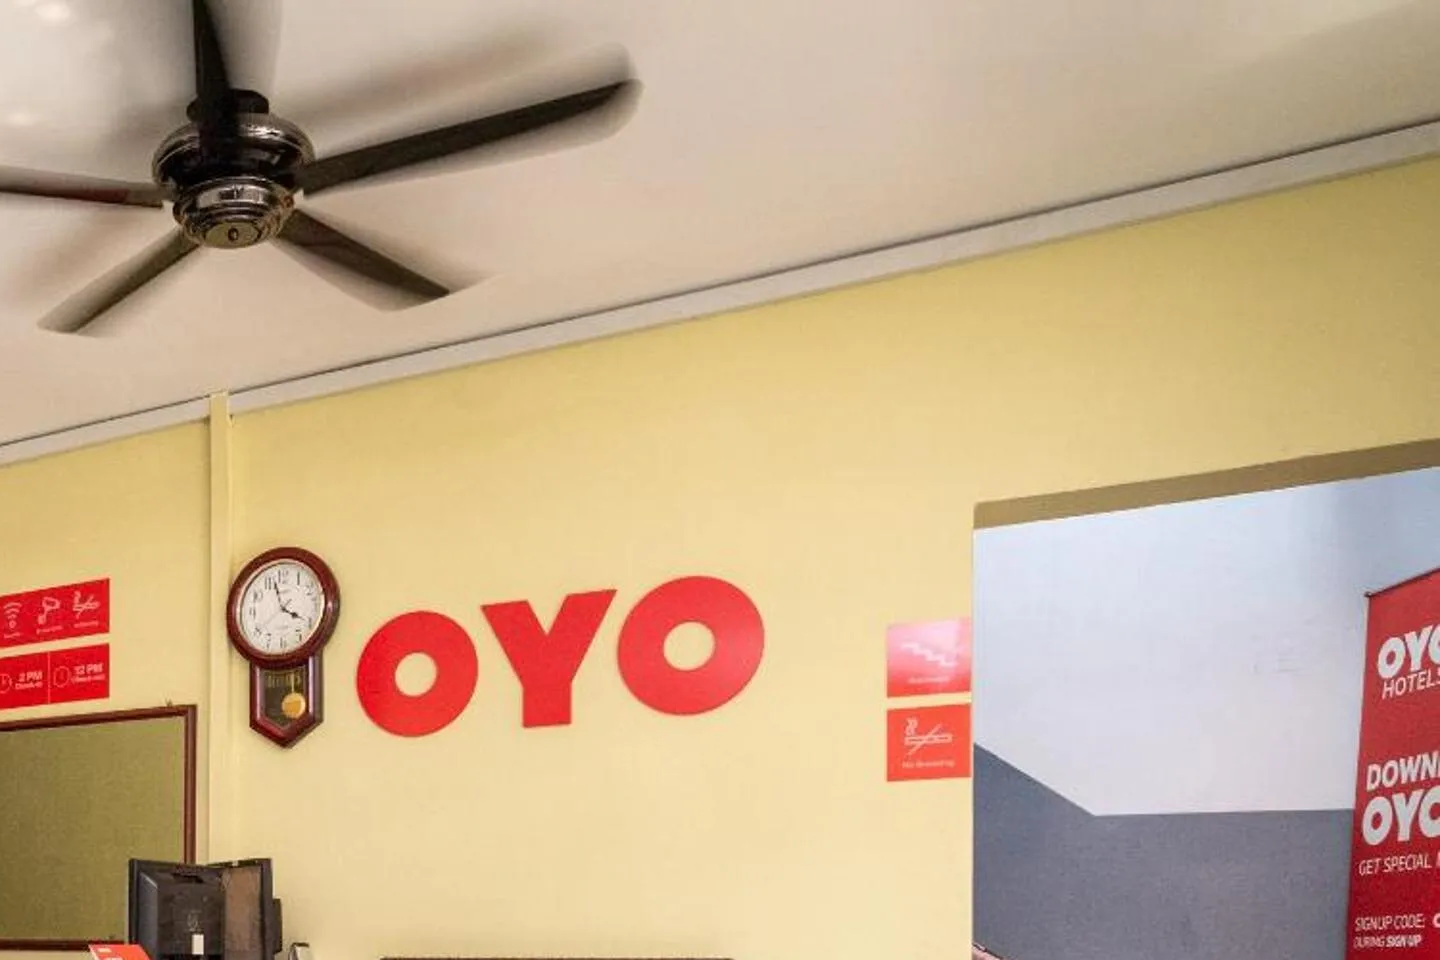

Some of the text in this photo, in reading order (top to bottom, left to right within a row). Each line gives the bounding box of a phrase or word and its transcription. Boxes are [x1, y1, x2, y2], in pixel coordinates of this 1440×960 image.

[356, 576, 765, 738] OYO
[1381, 665, 1440, 700] HOTEL
[1366, 750, 1440, 792] DOWN
[1359, 857, 1381, 876] GET
[1382, 853, 1433, 874] SPECIAL
